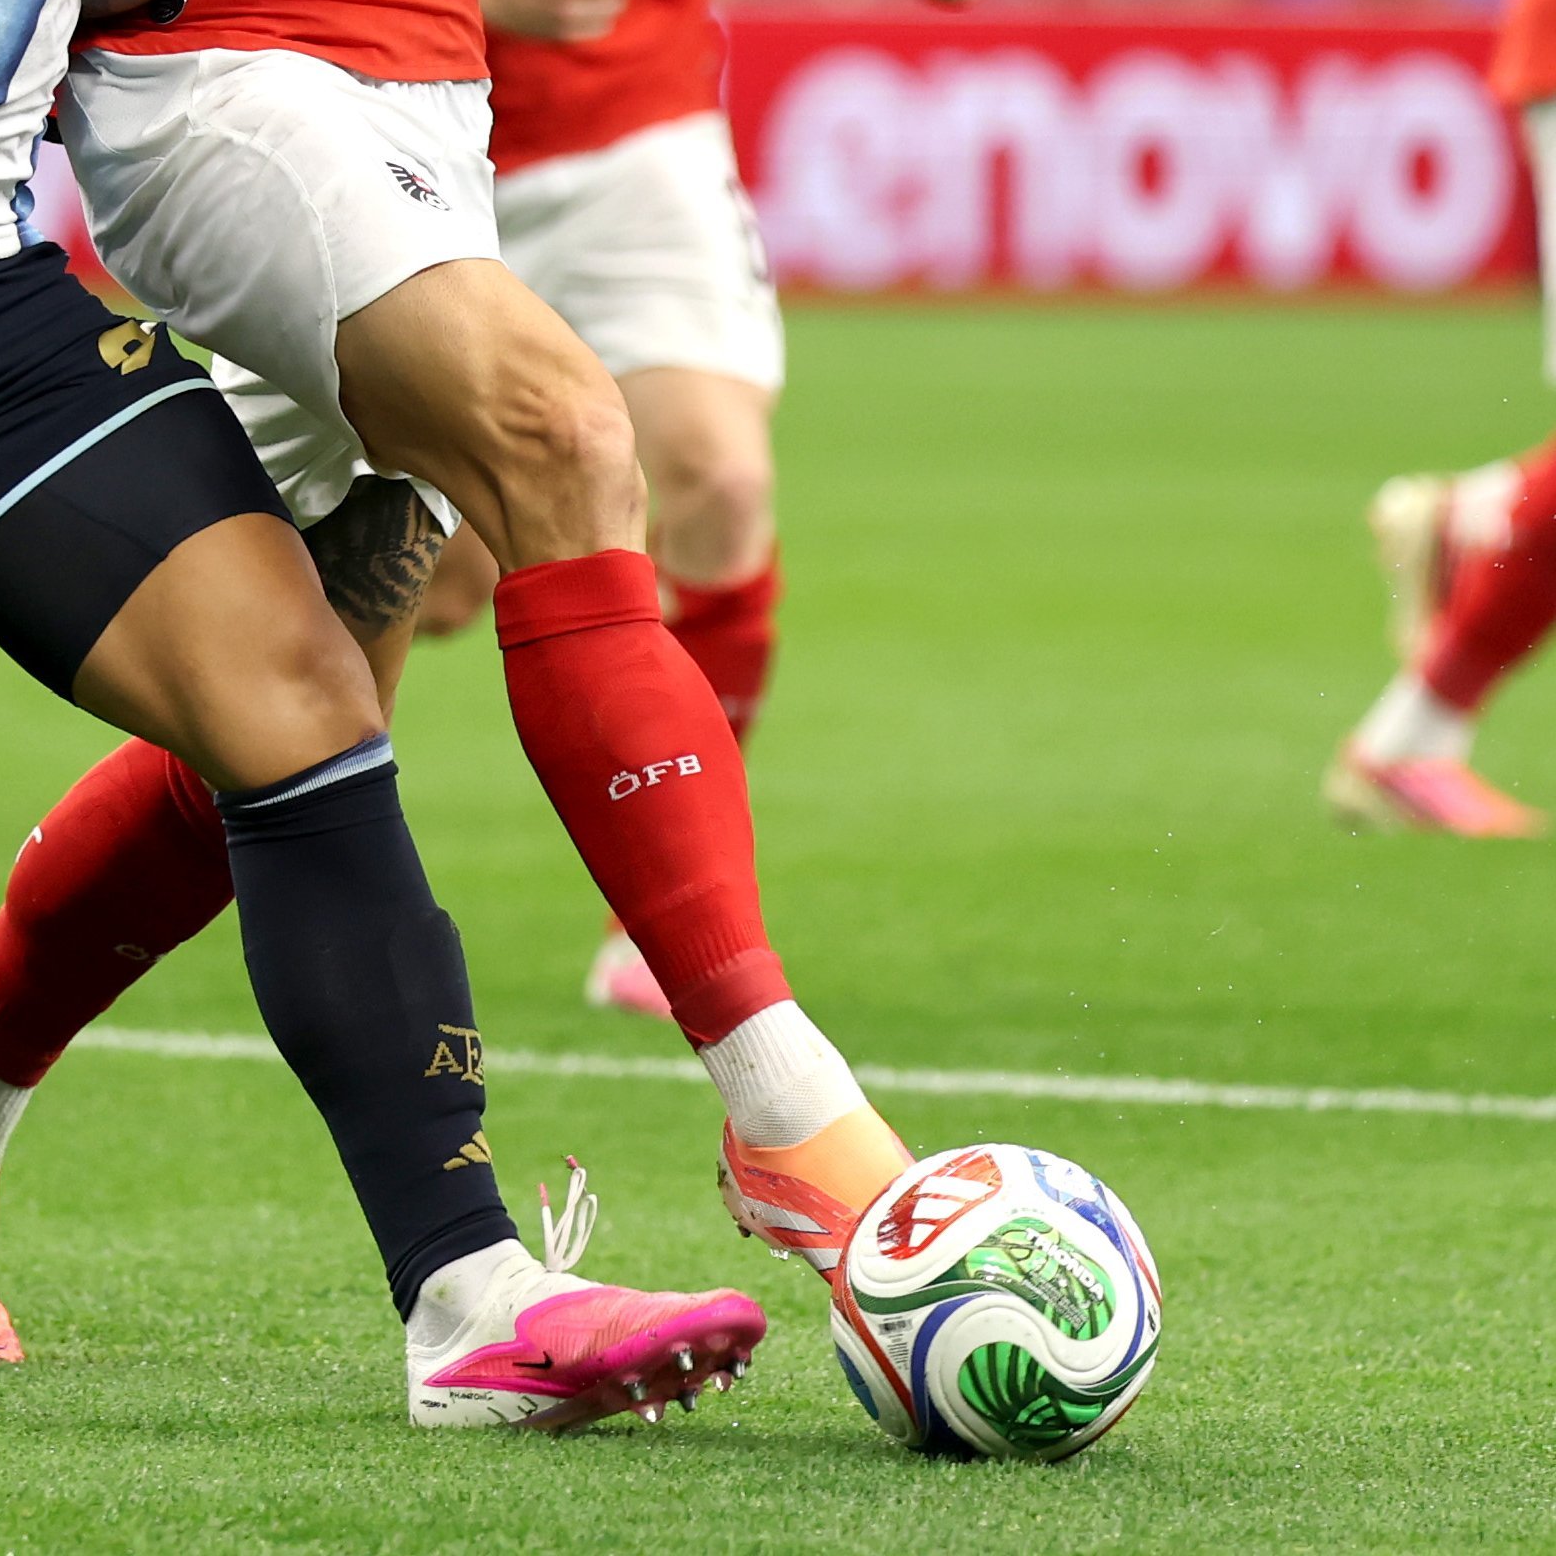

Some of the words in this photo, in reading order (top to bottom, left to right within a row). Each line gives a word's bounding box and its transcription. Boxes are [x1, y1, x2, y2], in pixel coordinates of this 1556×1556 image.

[758, 49, 1512, 290] enovo
[608, 754, 702, 801] ÖFB
[1024, 1227, 1105, 1301] TRIONDA
